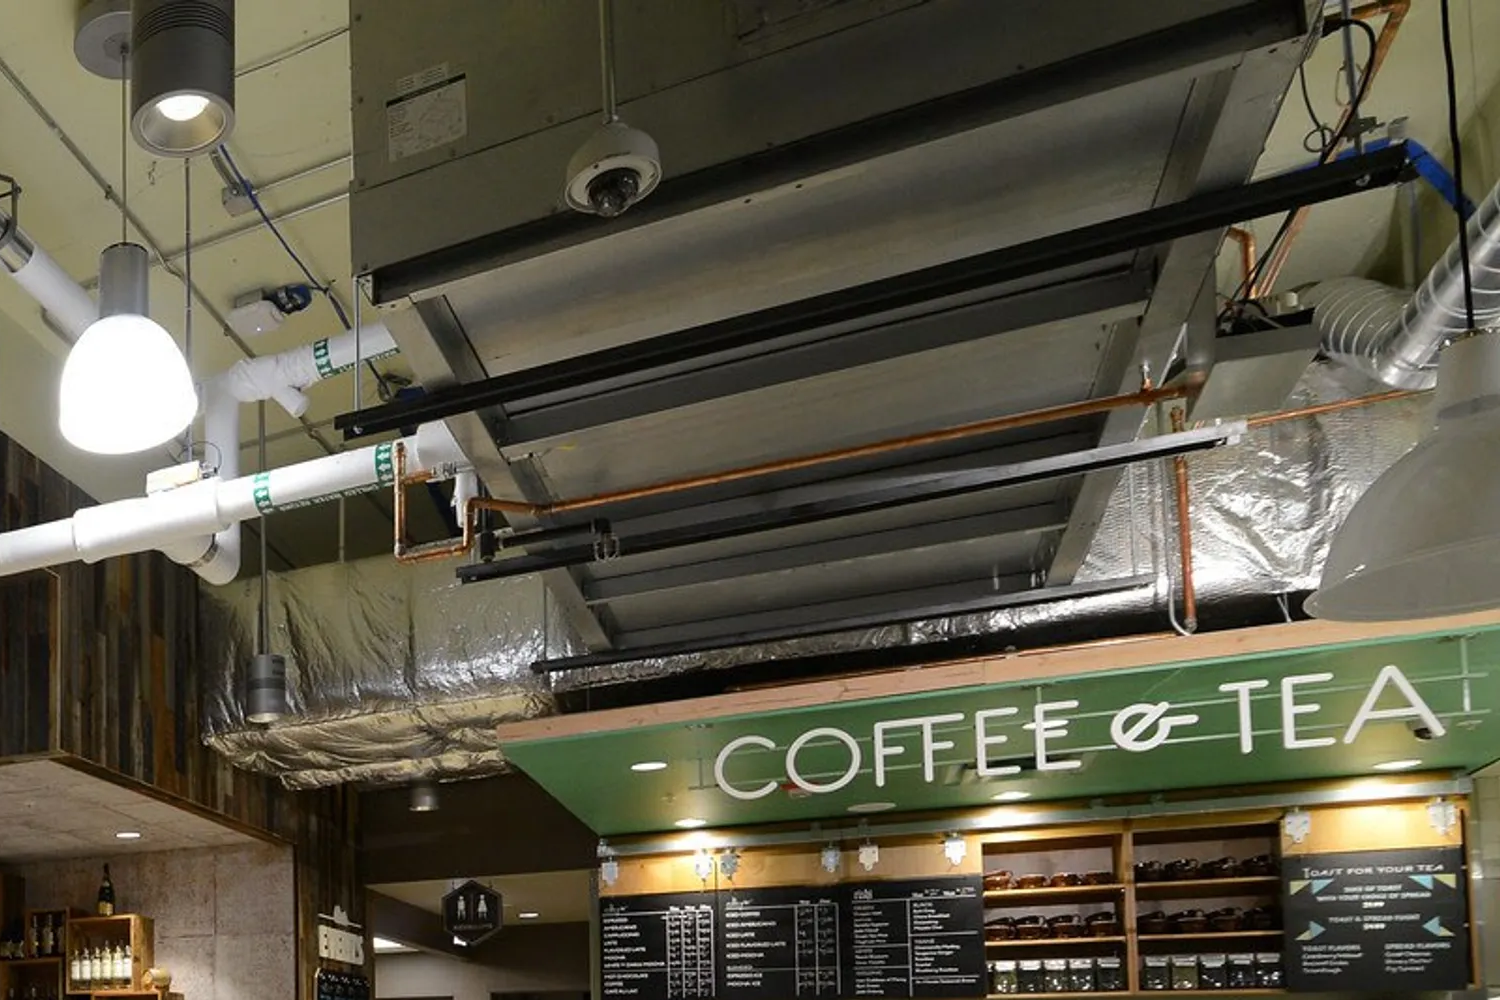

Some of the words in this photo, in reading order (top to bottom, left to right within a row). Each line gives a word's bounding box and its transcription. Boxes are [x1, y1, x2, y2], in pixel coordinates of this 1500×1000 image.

[713, 700, 1081, 800] COFFEE
[1110, 701, 1199, 753] &
[1218, 665, 1446, 755] TEA
[1302, 866, 1343, 879] TOAST
[1347, 867, 1373, 876] FOR
[1377, 865, 1413, 873] YOUR
[1416, 864, 1444, 872] TEA
